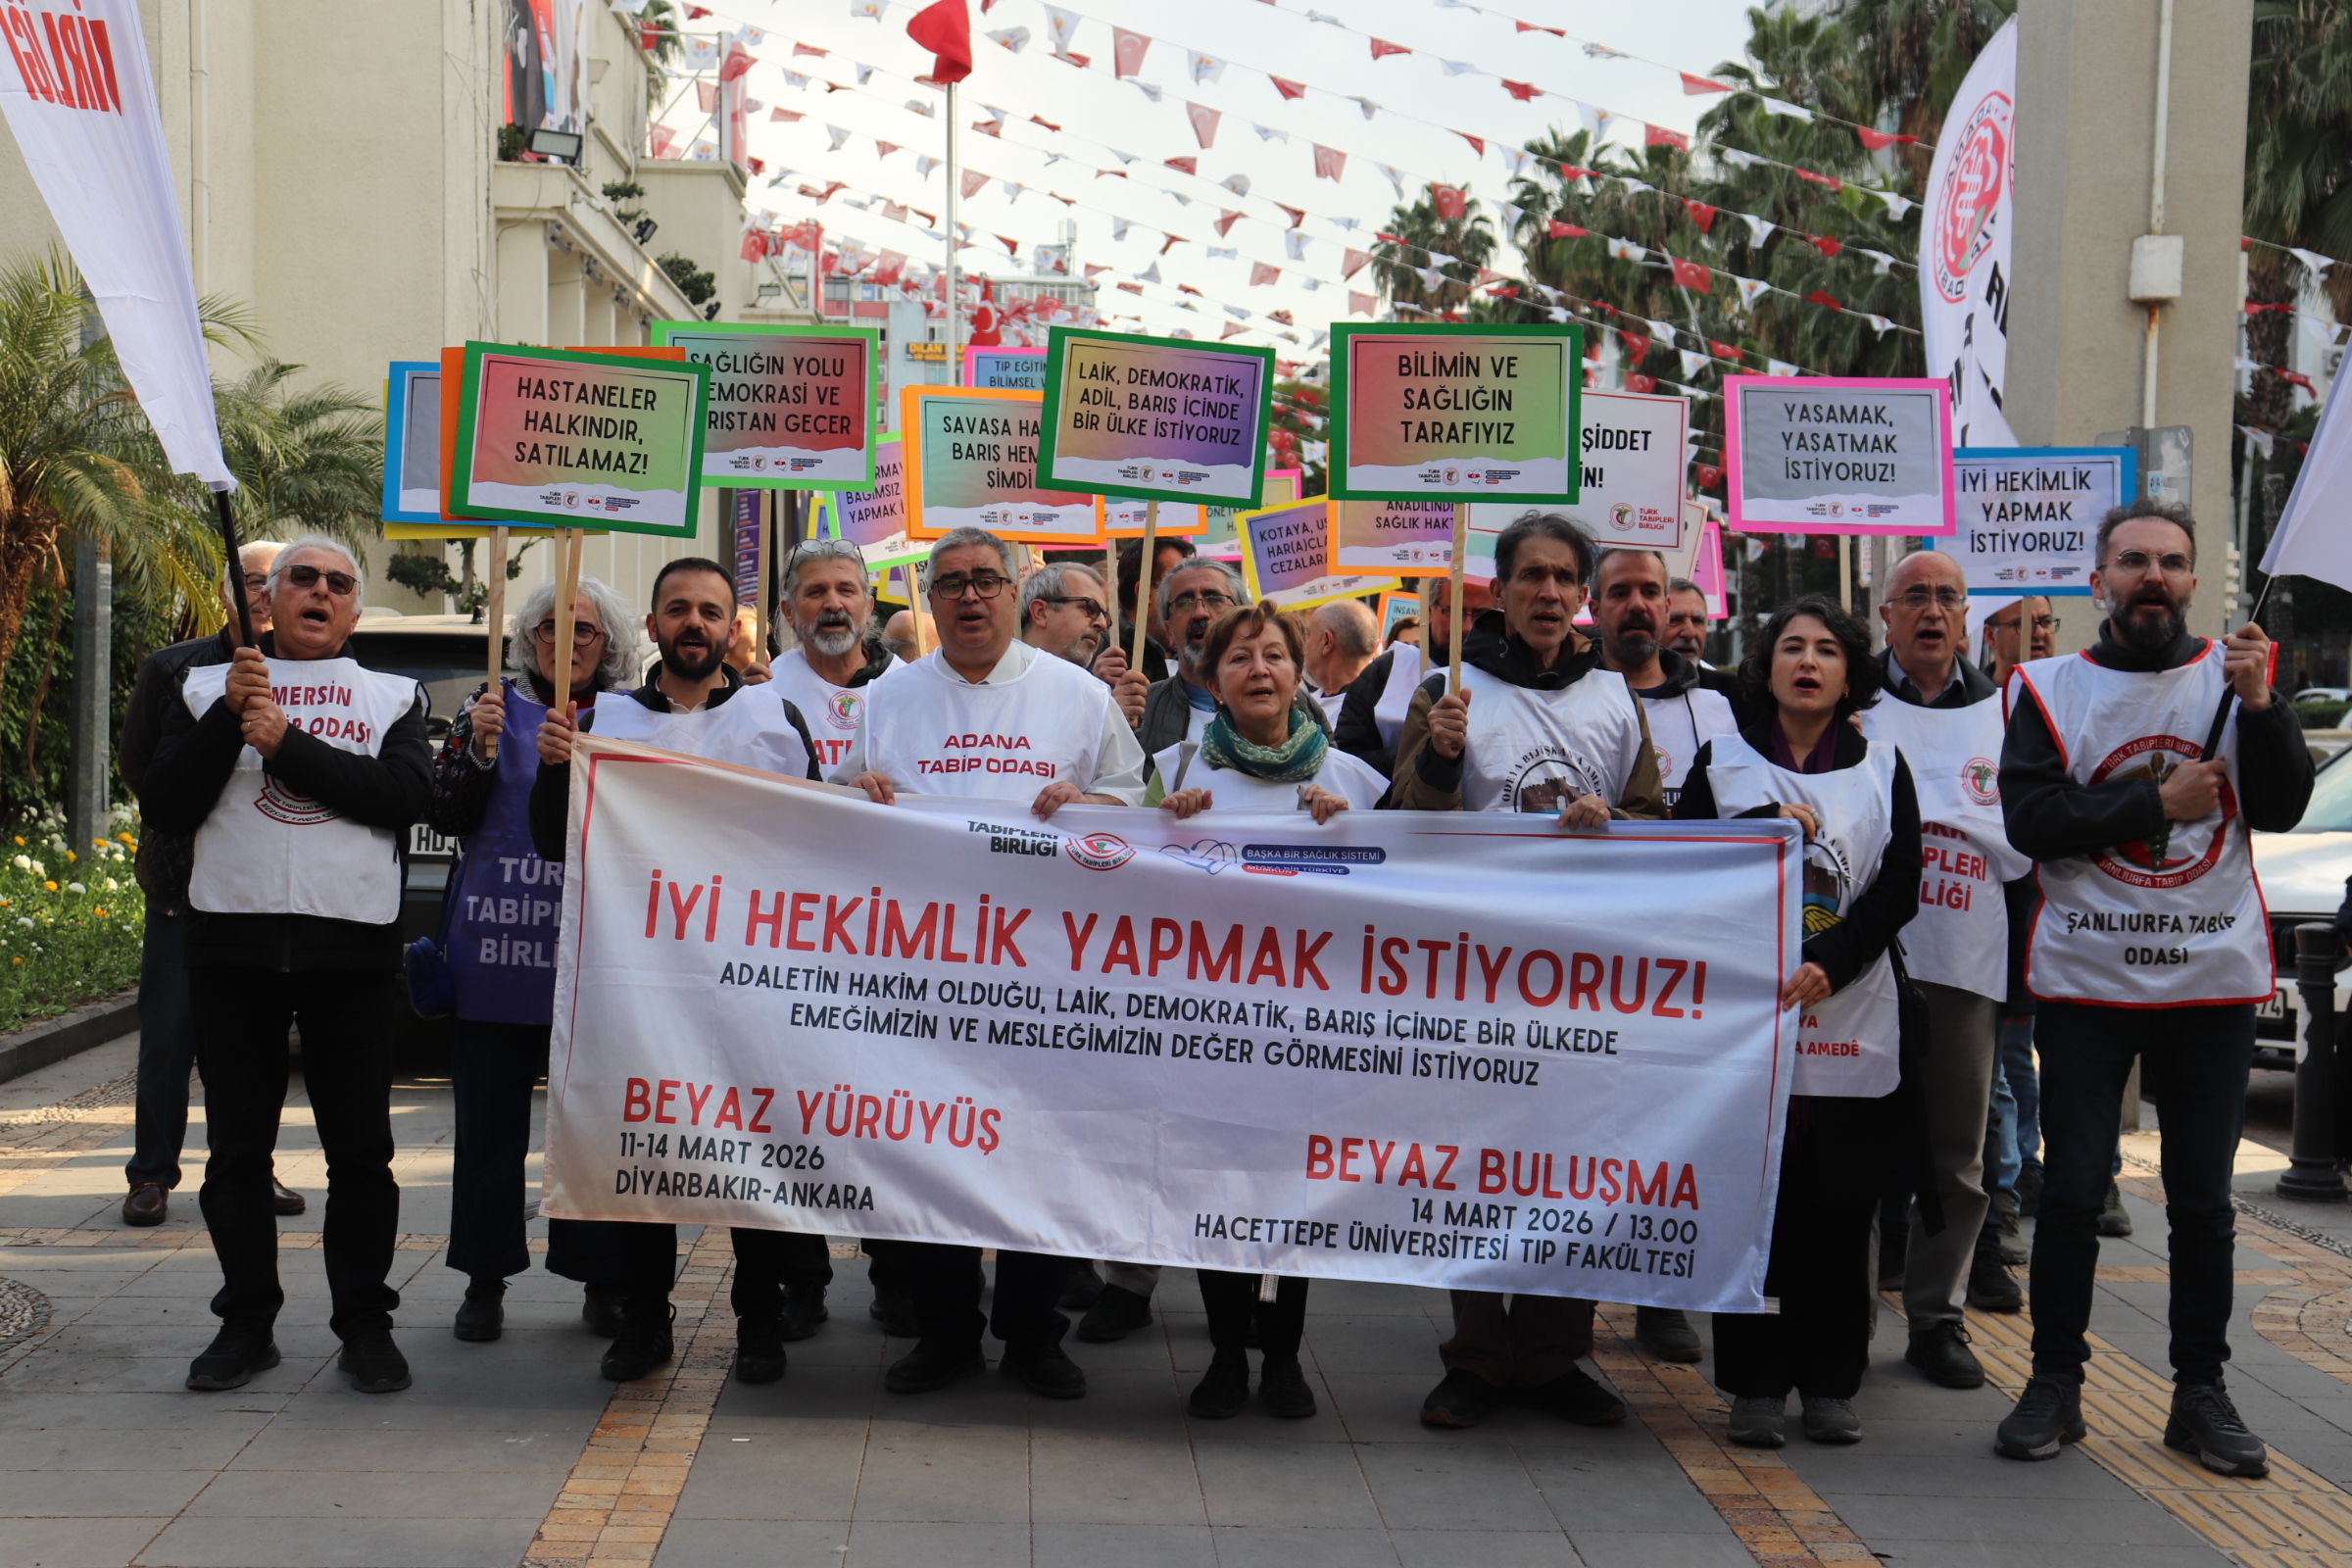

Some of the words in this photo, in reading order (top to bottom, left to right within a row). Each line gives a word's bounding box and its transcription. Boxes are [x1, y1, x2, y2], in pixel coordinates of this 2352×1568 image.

[690, 350, 784, 375] SAĞLIĞIN
[793, 356, 845, 377] YOLU
[995, 360, 1010, 372] TIP
[1398, 351, 1480, 378] BİLİMİN
[1491, 356, 1518, 378] VE
[709, 380, 808, 405] EMOKRASİ
[815, 385, 840, 406] VE
[989, 374, 1036, 388] BİLİMSEL
[1079, 361, 1120, 385] LAİK,
[1127, 367, 1244, 399] DEMOKRATİK,
[516, 376, 657, 412] HASTANELER
[1079, 386, 1121, 411] ADİL,
[1128, 392, 1177, 416] BARIŞ
[1183, 395, 1240, 420] İÇİNDE
[1403, 384, 1512, 412] SAĞLIĞIN
[524, 410, 643, 446] HALKINDIR,
[708, 410, 777, 432] RIŞTAN
[784, 414, 852, 436] GEÇER
[943, 416, 1011, 437] SAVAŞA
[1073, 410, 1100, 431] BİR
[1106, 413, 1148, 436] ÜLKE
[1153, 417, 1241, 446] İSTİYORUZ
[1784, 403, 1893, 427] YAŞAMAK,
[1400, 420, 1515, 445] TARAFIYIZ
[1582, 422, 1652, 453] ŞİDDET
[1782, 431, 1897, 453] YAŞATMAK
[514, 441, 649, 475] SATILAMAZ!
[953, 442, 1001, 464] BARIŞ
[987, 466, 1032, 489] ŞİMDİ
[1785, 457, 1895, 482] İSTİYORUZ!
[1962, 468, 1986, 492] İYİ
[1996, 466, 2091, 491] HEKİMLİK
[850, 503, 897, 524] YAPMAK
[1376, 515, 1420, 529] SAĞLIK
[1983, 502, 2073, 522] YAPMAK
[1259, 522, 1313, 542] KOTAYA,
[1971, 529, 2083, 553] İSTİYORUZ!
[271, 680, 352, 707] MERSİN
[309, 717, 371, 744] ODASI
[944, 734, 1031, 750] ADANA
[917, 755, 982, 774] TABİP
[986, 758, 1055, 779] ODASI
[2102, 752, 2128, 770] TÜRK
[2126, 738, 2175, 756] TABİPLERİ
[991, 835, 1058, 858] BİRLİĞİ
[1069, 845, 1082, 860] TÜRK
[1082, 856, 1112, 868] TABİPLERİ
[1247, 849, 1282, 859] BAŞKA
[1284, 850, 1299, 859] BİR
[1302, 850, 1339, 860] SAĞLIK
[1341, 851, 1380, 861] SİSTEMİ
[499, 853, 564, 886] TÜR
[1922, 847, 1987, 881] PLERİ
[2099, 858, 2152, 887] ŞANLIURFA
[2156, 876, 2184, 887] TABİP
[2186, 858, 2213, 881] ODASI
[1921, 879, 1972, 911] LİĞİ
[2067, 912, 2183, 934] ŞANLIURFA
[2188, 911, 2236, 934] TABİP
[479, 933, 561, 968] BİRLİ
[644, 868, 723, 943] İYİ
[745, 885, 1032, 968] HEKİMLİK
[1062, 910, 1334, 992] YAPMAK
[1360, 924, 1708, 1020] İSTİYORUZ!
[2125, 947, 2188, 965] ODASI
[719, 961, 839, 996] ADALETİN
[849, 970, 928, 1003] HAKİM
[937, 980, 1047, 1014] OLDUĞU,
[1056, 984, 1116, 1018] LAİK,
[1126, 994, 1295, 1034] DEMOKRATİK,
[1305, 1007, 1376, 1037] BARIŞ
[1386, 1008, 1467, 1044] İÇİNDE
[1477, 1017, 1516, 1048] BİR
[1526, 1019, 1619, 1055] ÜLKEDE
[790, 1003, 938, 1041] EMEĞİMİZİN
[950, 1016, 978, 1044] VE
[988, 1019, 1161, 1057] MESLEĞİMİZİN
[1171, 1031, 1253, 1064] DEĞER
[1264, 1040, 1403, 1076] GÖRMESİNİ
[1412, 1048, 1540, 1087] İSTİYORUZ
[1807, 1039, 1859, 1056] AMEDÊ
[623, 1077, 776, 1134] BEYAZ
[796, 1084, 1003, 1156] YÜRÜYÜŞ
[619, 1132, 668, 1159] 11-14
[678, 1136, 753, 1165] MART
[761, 1142, 825, 1170] 2026
[1305, 1134, 1460, 1192] BEYAZ
[1478, 1148, 1699, 1211] BULUŞMA
[615, 1164, 875, 1211] DİYARBAKIR-ANKARA
[1411, 1197, 1434, 1225] 14
[1445, 1200, 1518, 1230] MART
[1528, 1207, 1593, 1236] 2026
[1604, 1212, 1619, 1237] /
[1630, 1215, 1699, 1245] 13.00
[1195, 1213, 1338, 1250] HACETTEPE
[1348, 1220, 1509, 1261] ÜNİVERSİTESİ
[1520, 1238, 1556, 1265] TIP
[1566, 1242, 1694, 1279] FAKÜLTESİ
